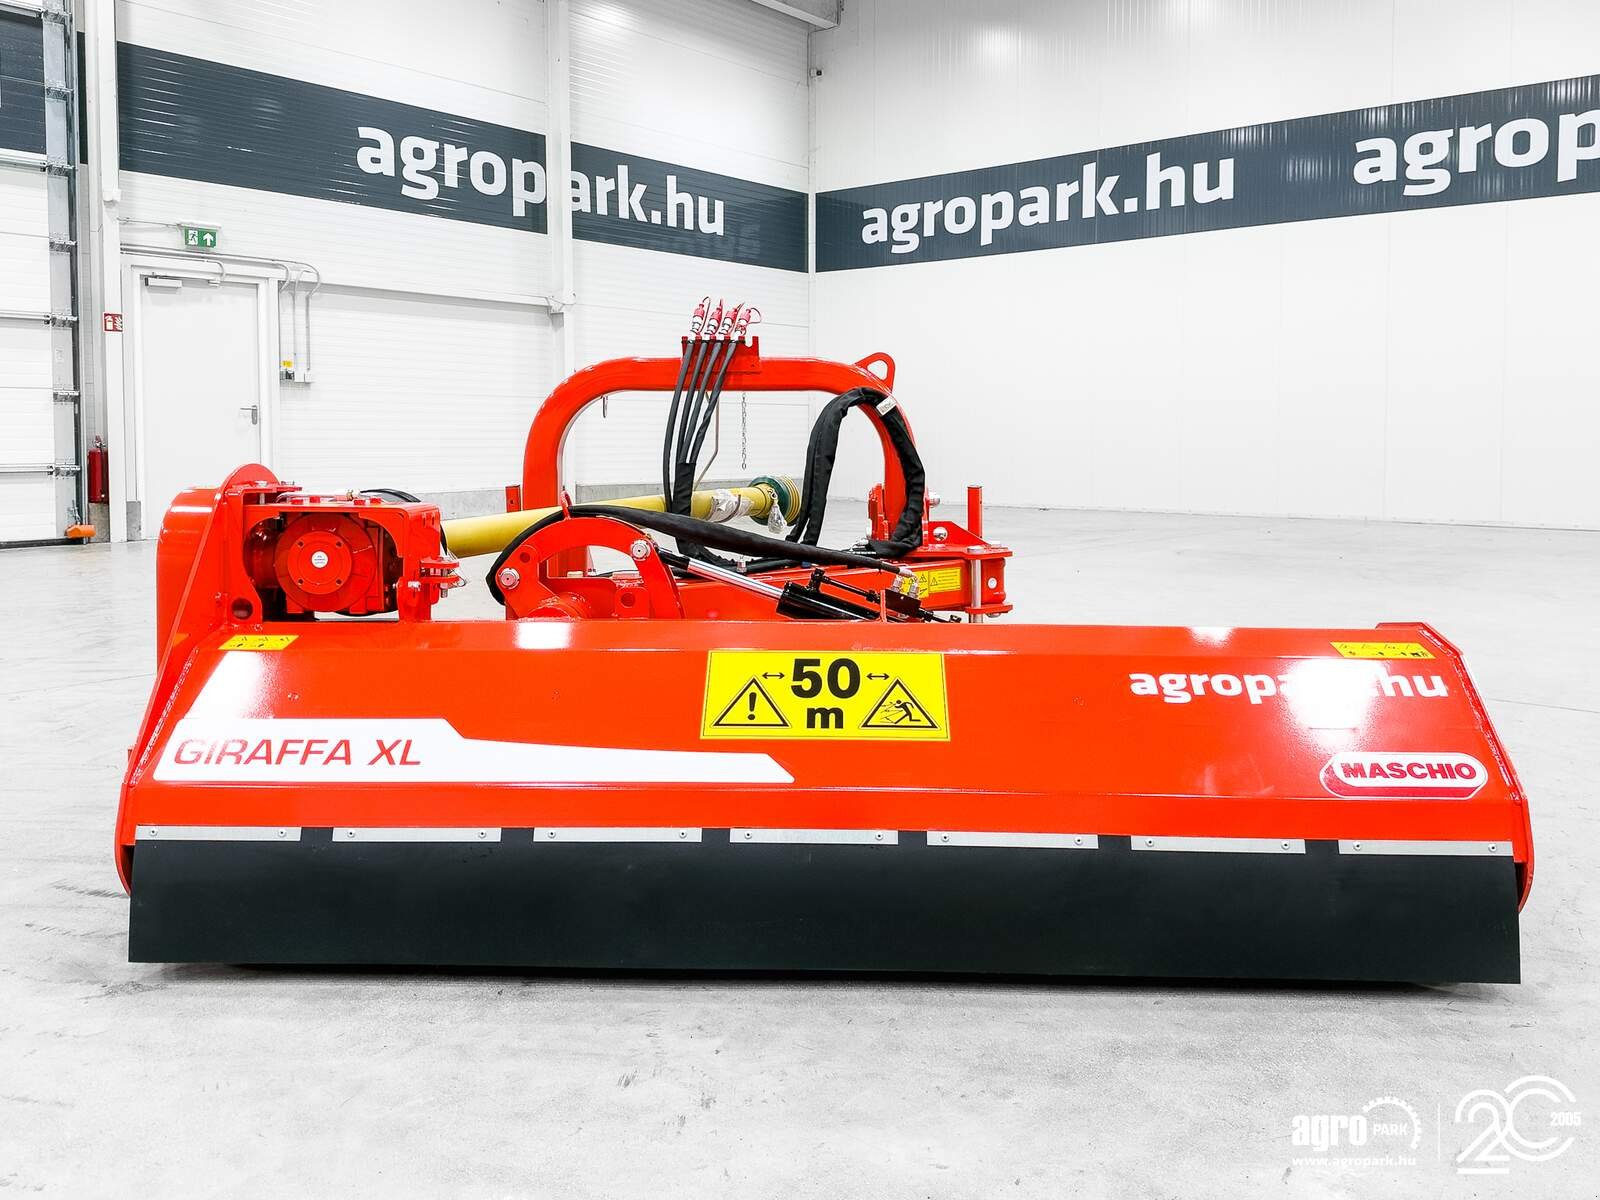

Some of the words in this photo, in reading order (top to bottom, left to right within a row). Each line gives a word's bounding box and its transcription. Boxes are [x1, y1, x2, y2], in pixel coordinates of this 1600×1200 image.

[1353, 109, 1600, 196] agrop
[861, 151, 1234, 254] agropark.hu
[791, 658, 861, 698] 50
[806, 707, 844, 729] m
[174, 739, 352, 766] GIRAFFA
[368, 739, 421, 766] XL
[1341, 762, 1476, 780] MASCHIO
